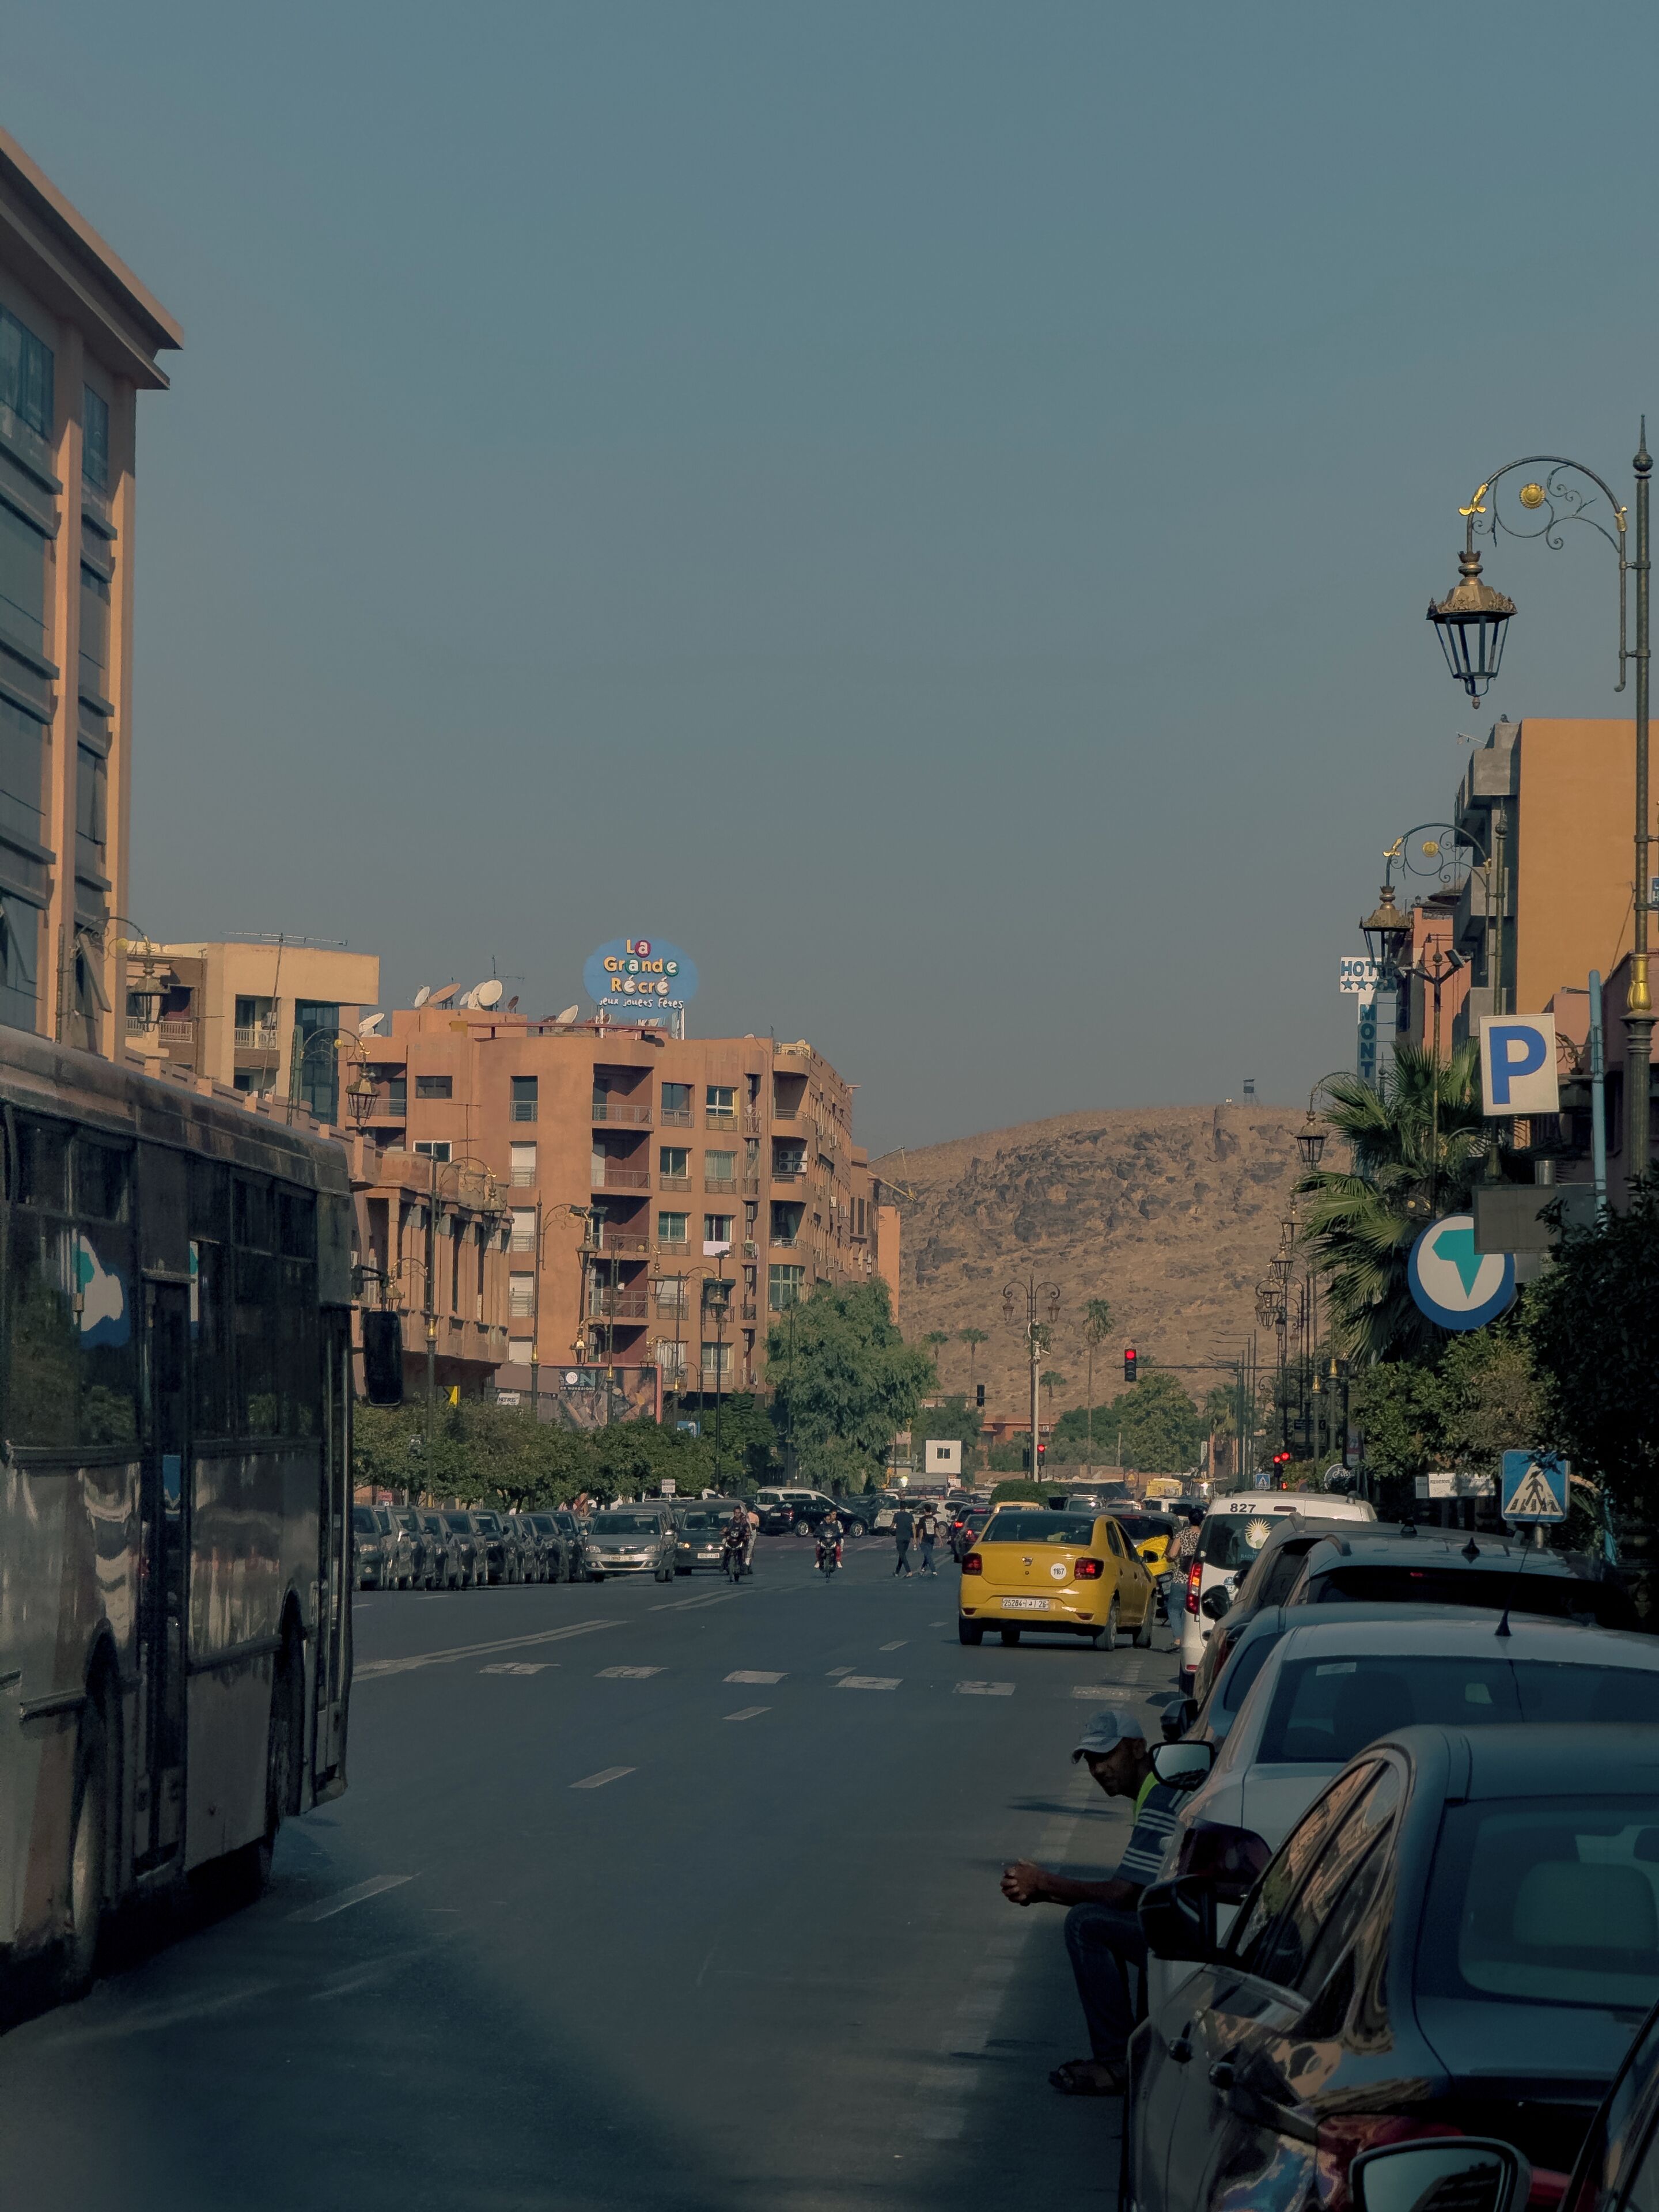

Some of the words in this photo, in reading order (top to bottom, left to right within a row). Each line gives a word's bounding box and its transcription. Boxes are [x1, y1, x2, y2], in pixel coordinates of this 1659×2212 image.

[626, 939, 650, 956] La
[604, 956, 678, 975] Grande
[611, 975, 669, 995] Récré
[599, 997, 619, 1006] jeux
[623, 998, 653, 1007] jouets
[1359, 1003, 1376, 1078] MONT
[1489, 1025, 1547, 1105] P
[1230, 1503, 1256, 1513] 827
